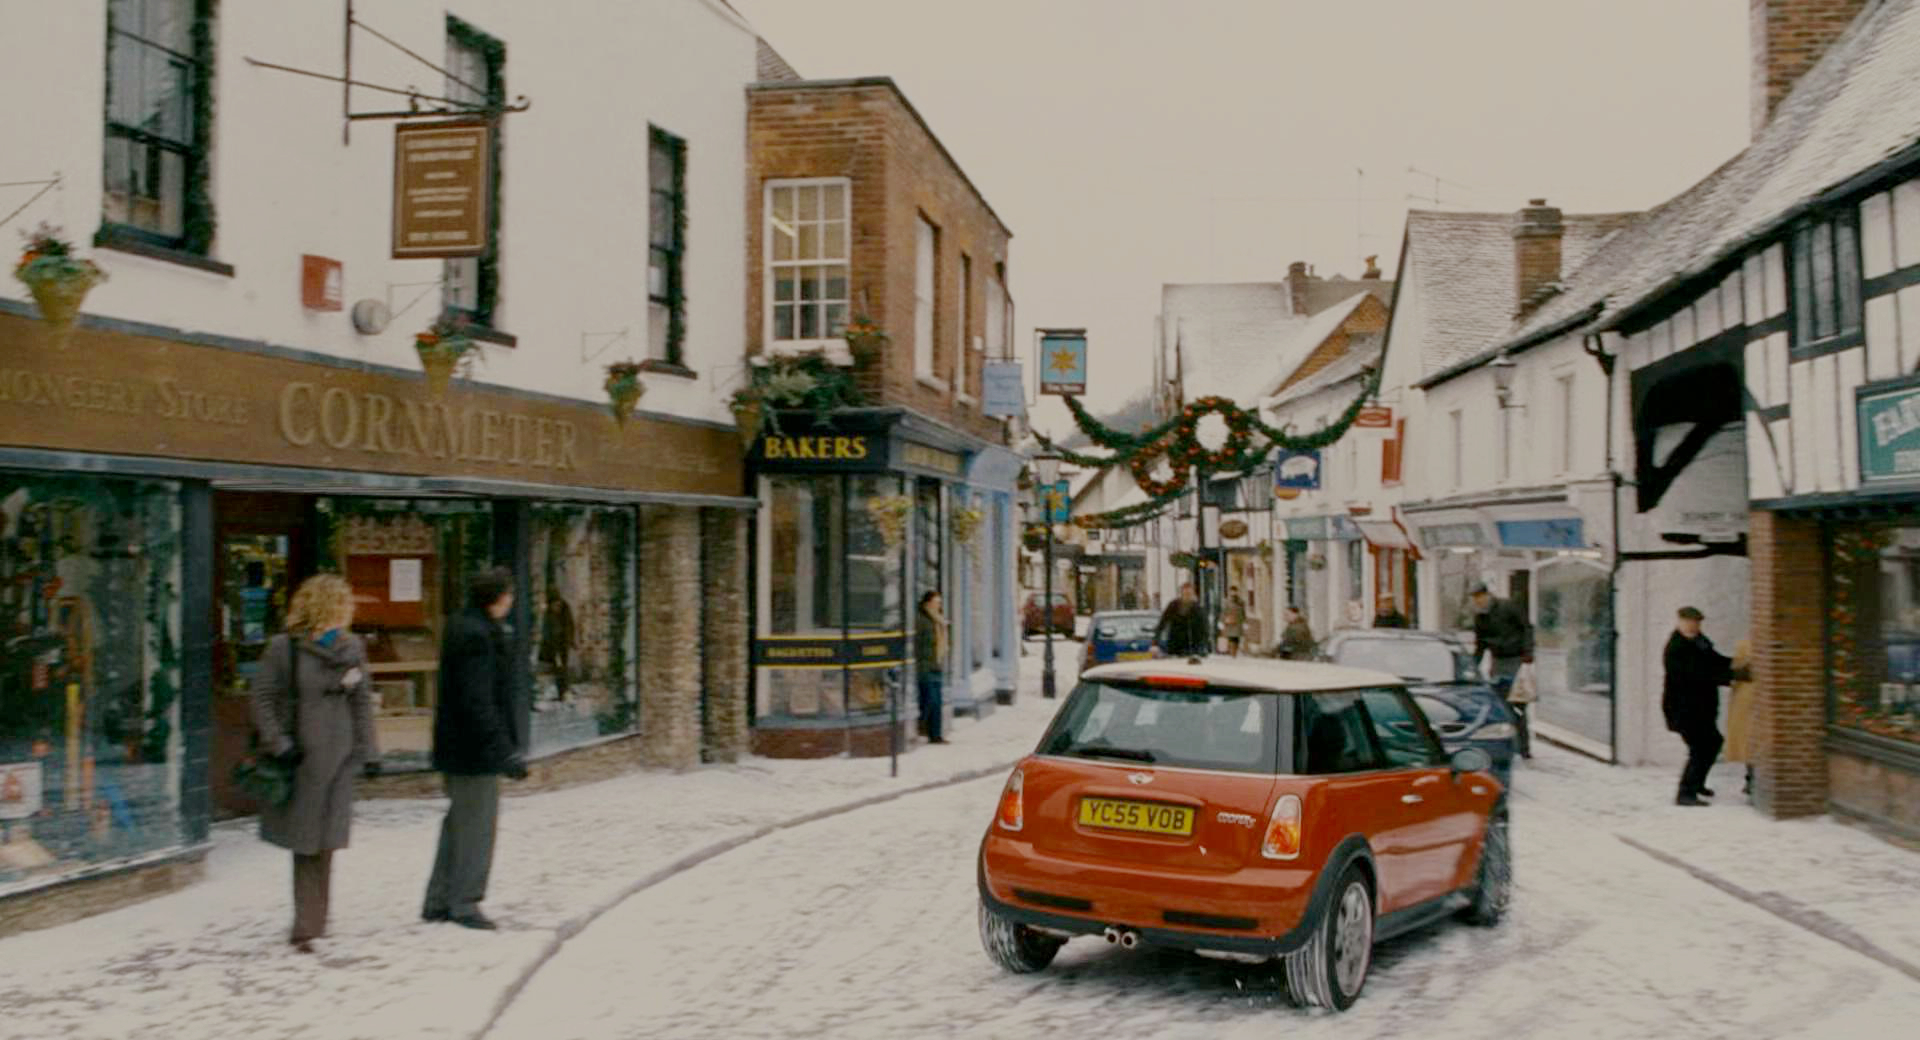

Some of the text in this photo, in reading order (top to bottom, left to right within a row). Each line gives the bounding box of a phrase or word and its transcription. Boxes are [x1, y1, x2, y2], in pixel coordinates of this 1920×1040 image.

[280, 382, 577, 470] CORNMETER
[764, 436, 867, 459] BAKERS
[1088, 802, 1185, 831] YC55 VOB
